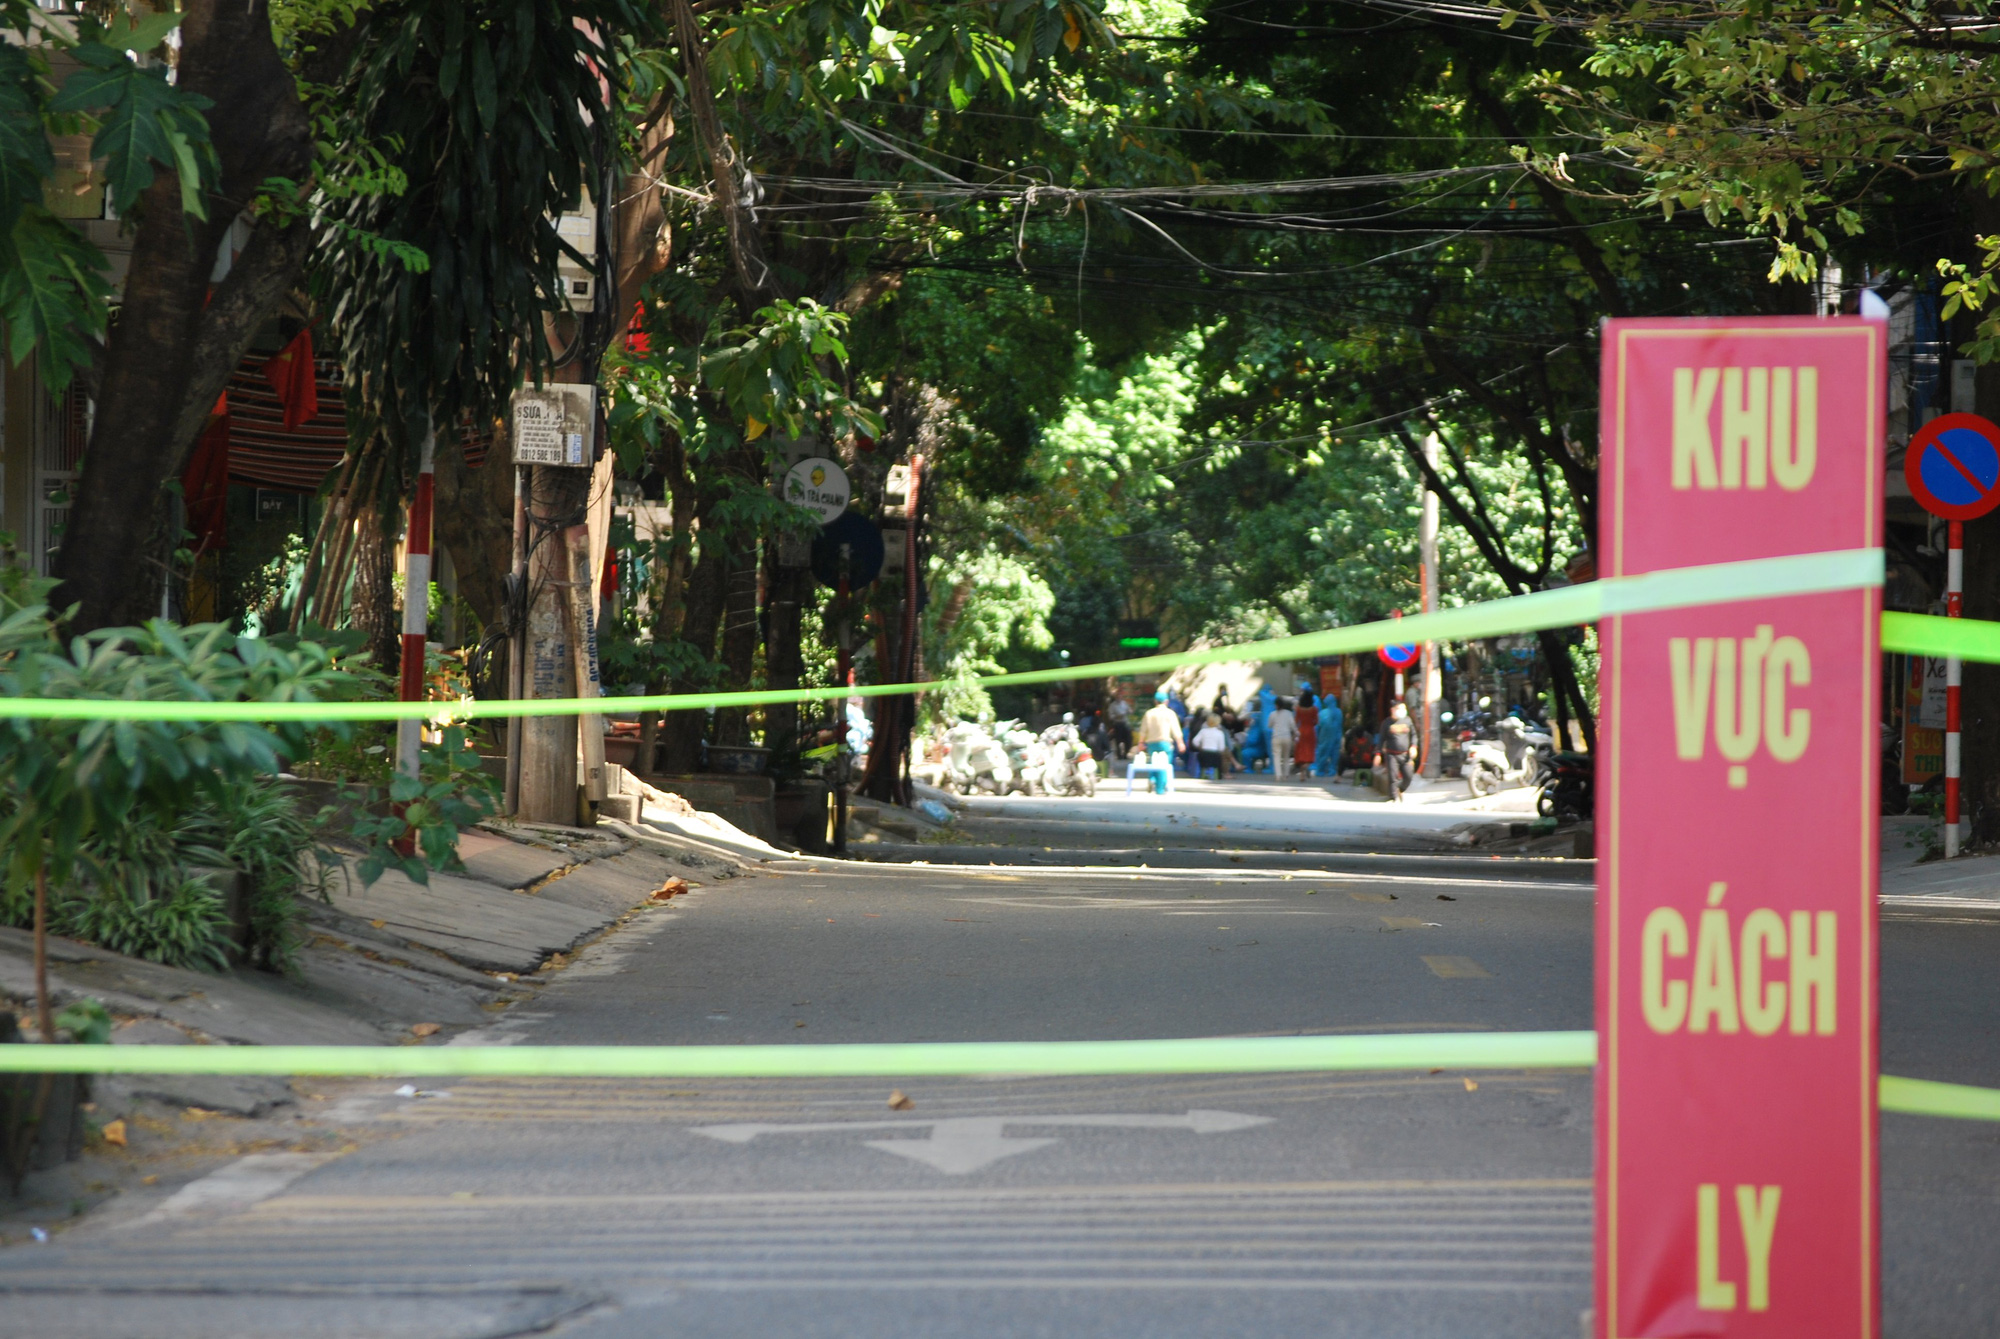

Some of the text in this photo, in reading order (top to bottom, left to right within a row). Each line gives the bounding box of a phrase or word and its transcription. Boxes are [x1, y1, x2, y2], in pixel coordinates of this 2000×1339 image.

[1671, 366, 1818, 491] KHU
[1669, 624, 1811, 789] VỰC
[1640, 881, 1837, 1037] CÁCH
[1697, 1184, 1782, 1312] LY
